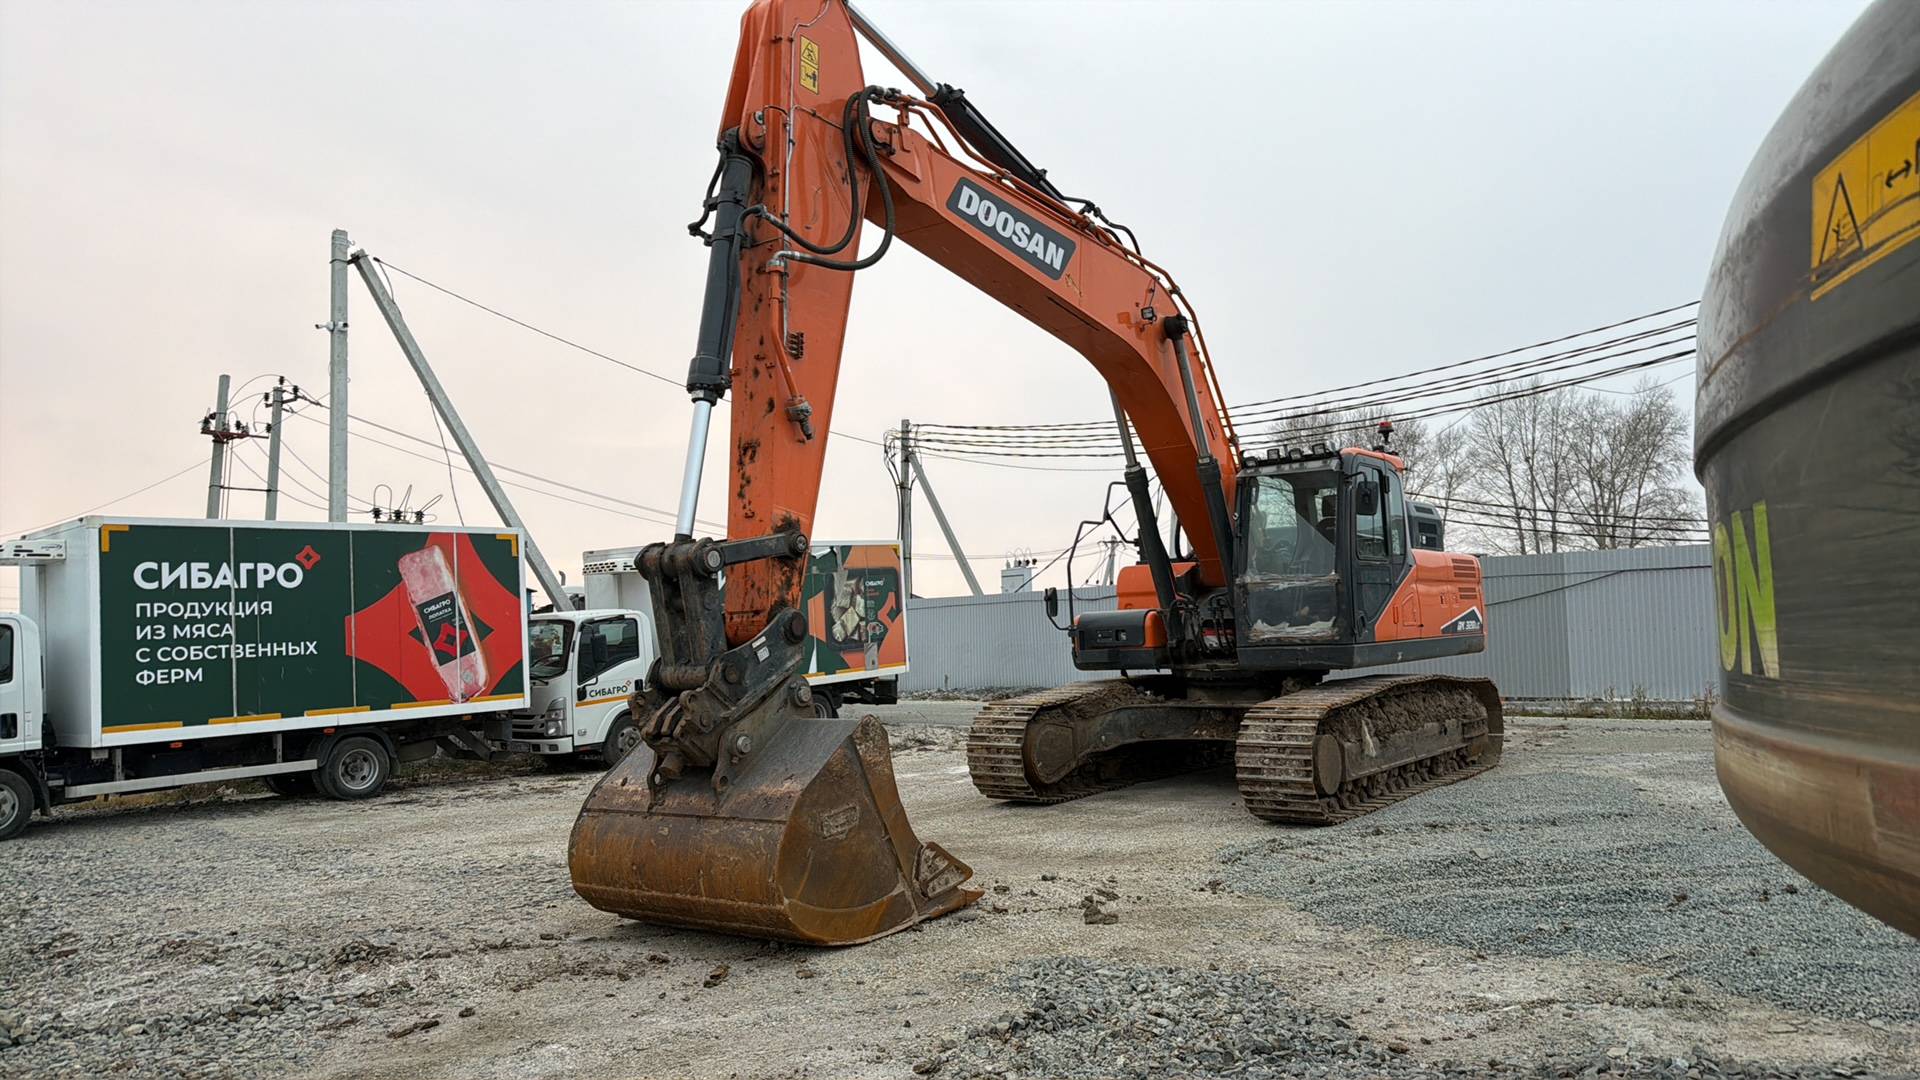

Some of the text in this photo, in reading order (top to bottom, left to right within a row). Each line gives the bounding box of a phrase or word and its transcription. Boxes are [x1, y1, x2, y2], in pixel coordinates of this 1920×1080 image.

[957, 185, 1065, 271] DOOSAN
[133, 561, 303, 590] СИБАГРО
[135, 601, 273, 619] ПРОДУКЦИЯ
[135, 622, 235, 641] ИЗ МЯСА
[135, 641, 318, 664] С СОБСТВЕННЫХ
[135, 667, 203, 686] ФЕРМ
[589, 686, 628, 698] СИБАГРО
